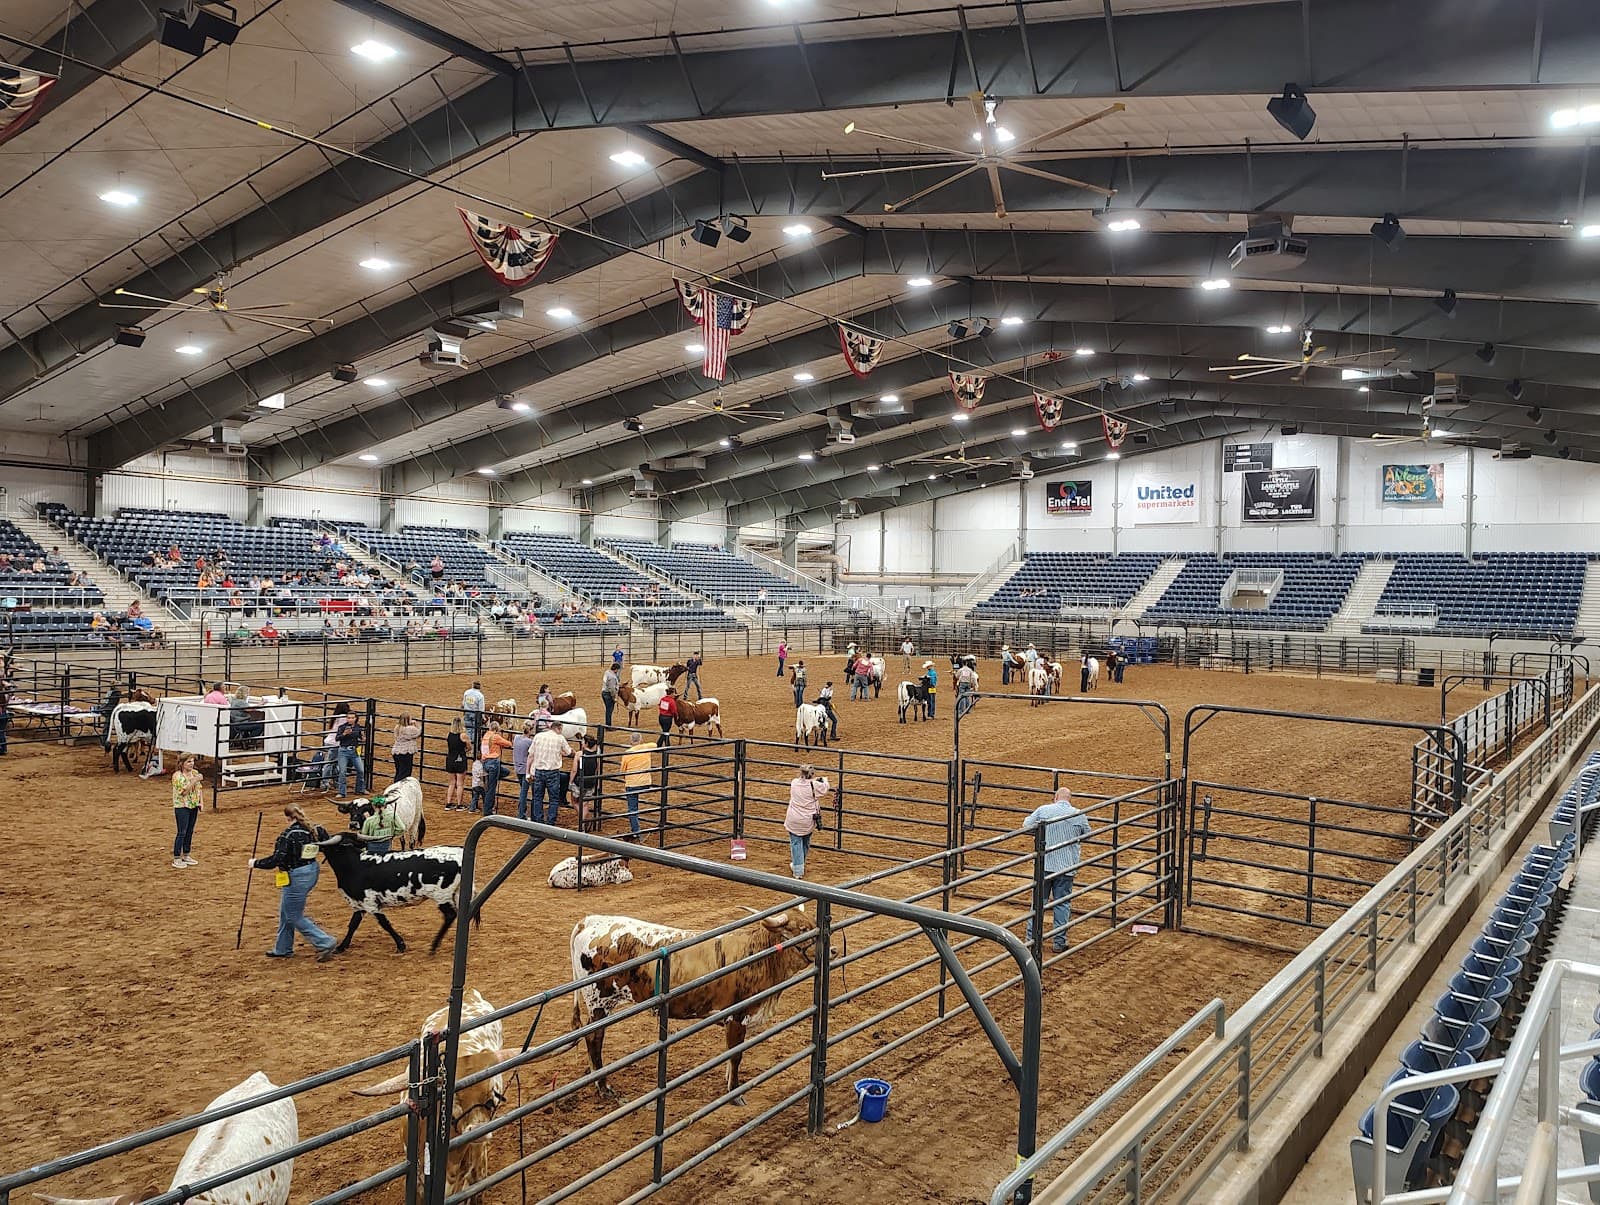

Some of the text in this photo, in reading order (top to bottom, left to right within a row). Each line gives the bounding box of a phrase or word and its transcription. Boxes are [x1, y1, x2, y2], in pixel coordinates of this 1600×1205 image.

[1137, 484, 1194, 500] United
[1048, 496, 1091, 507] Ener-Tel
[1137, 500, 1194, 509] supermarkets
